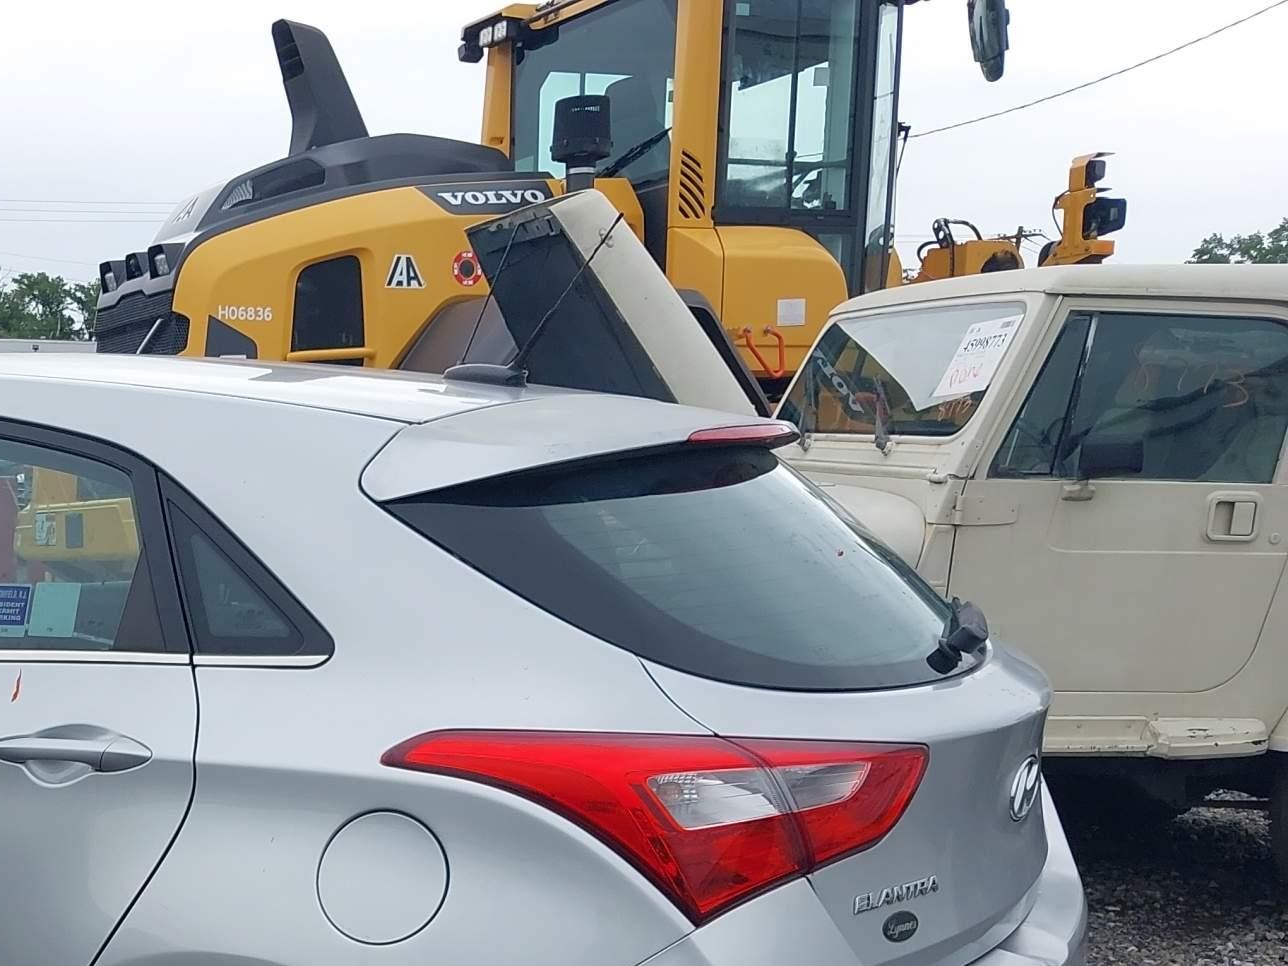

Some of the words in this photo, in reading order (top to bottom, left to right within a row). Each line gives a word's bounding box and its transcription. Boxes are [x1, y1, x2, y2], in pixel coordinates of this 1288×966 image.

[437, 189, 545, 206] VOLVO
[218, 304, 273, 321] H06836
[853, 875, 938, 915] ELANTRA
